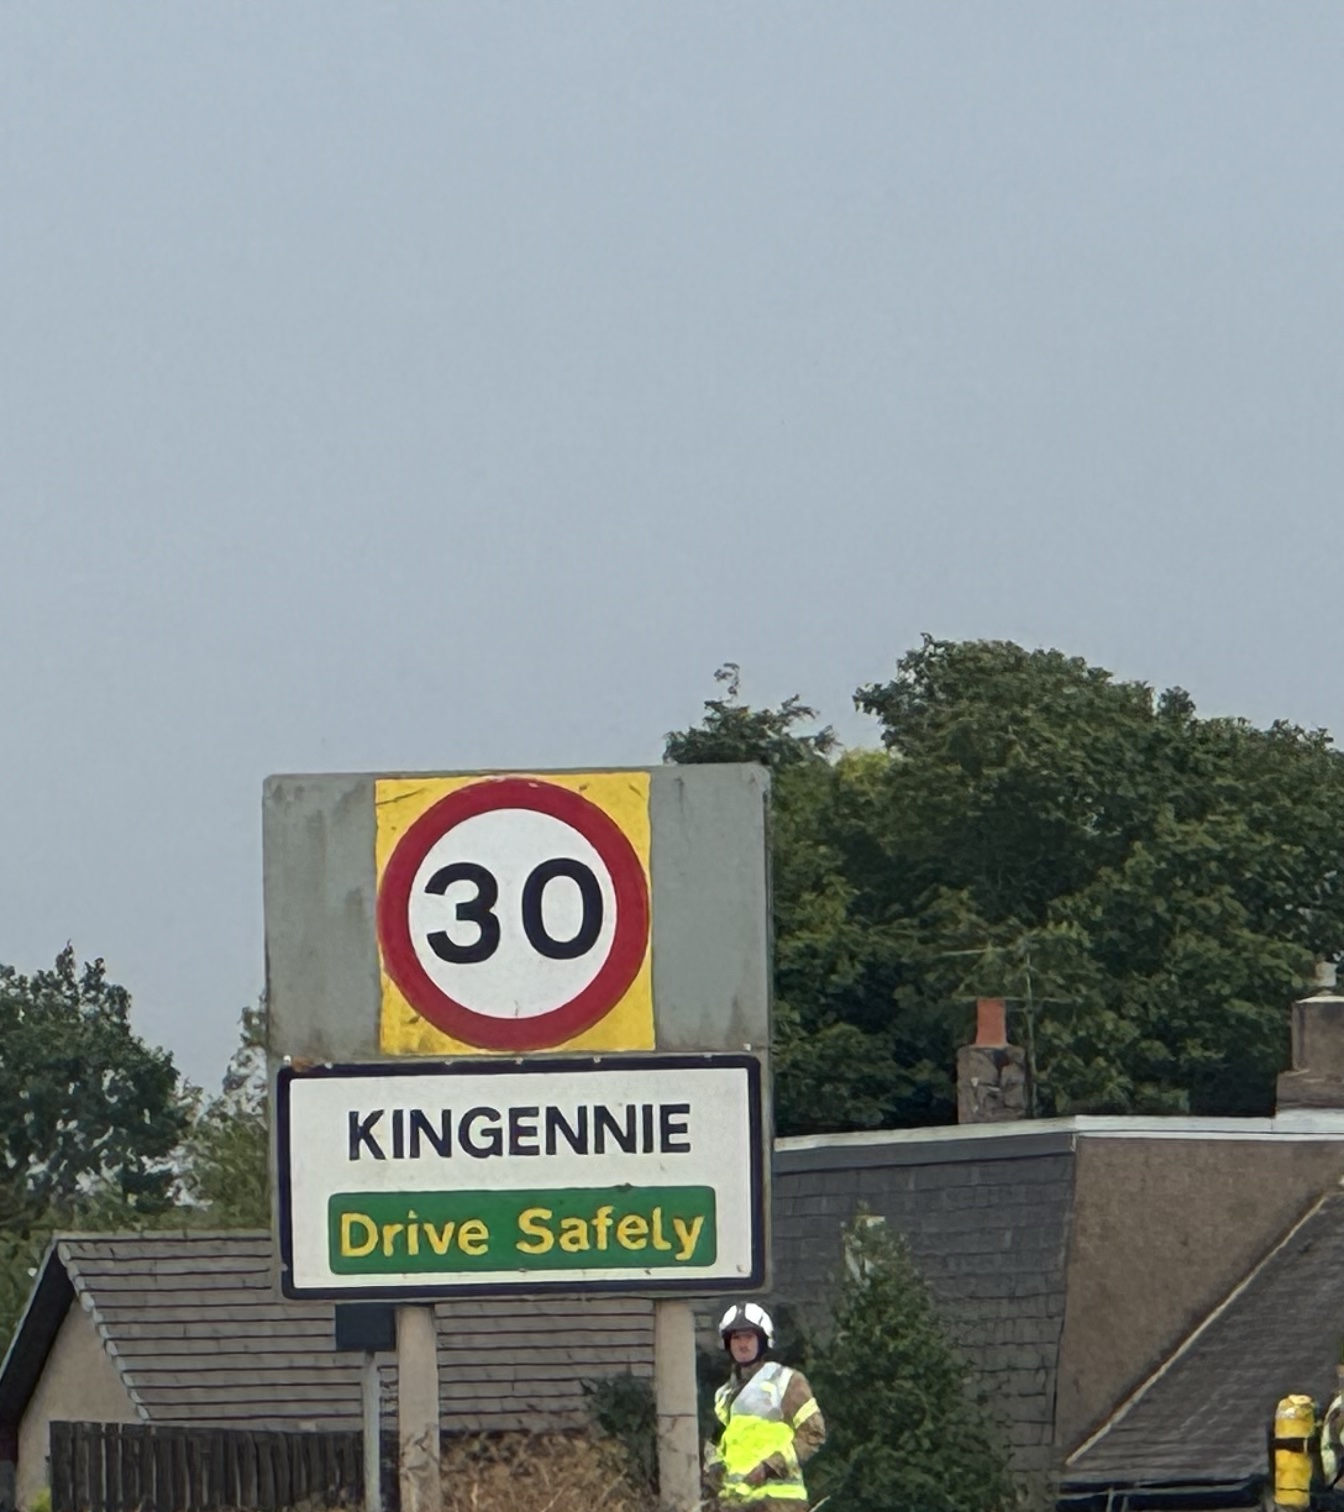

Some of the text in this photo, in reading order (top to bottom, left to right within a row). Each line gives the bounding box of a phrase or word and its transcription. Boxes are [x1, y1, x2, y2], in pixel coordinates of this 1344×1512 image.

[423, 857, 604, 964] 30
[348, 1103, 691, 1161] KINGENNIE
[340, 1206, 705, 1261] Drive Safely
